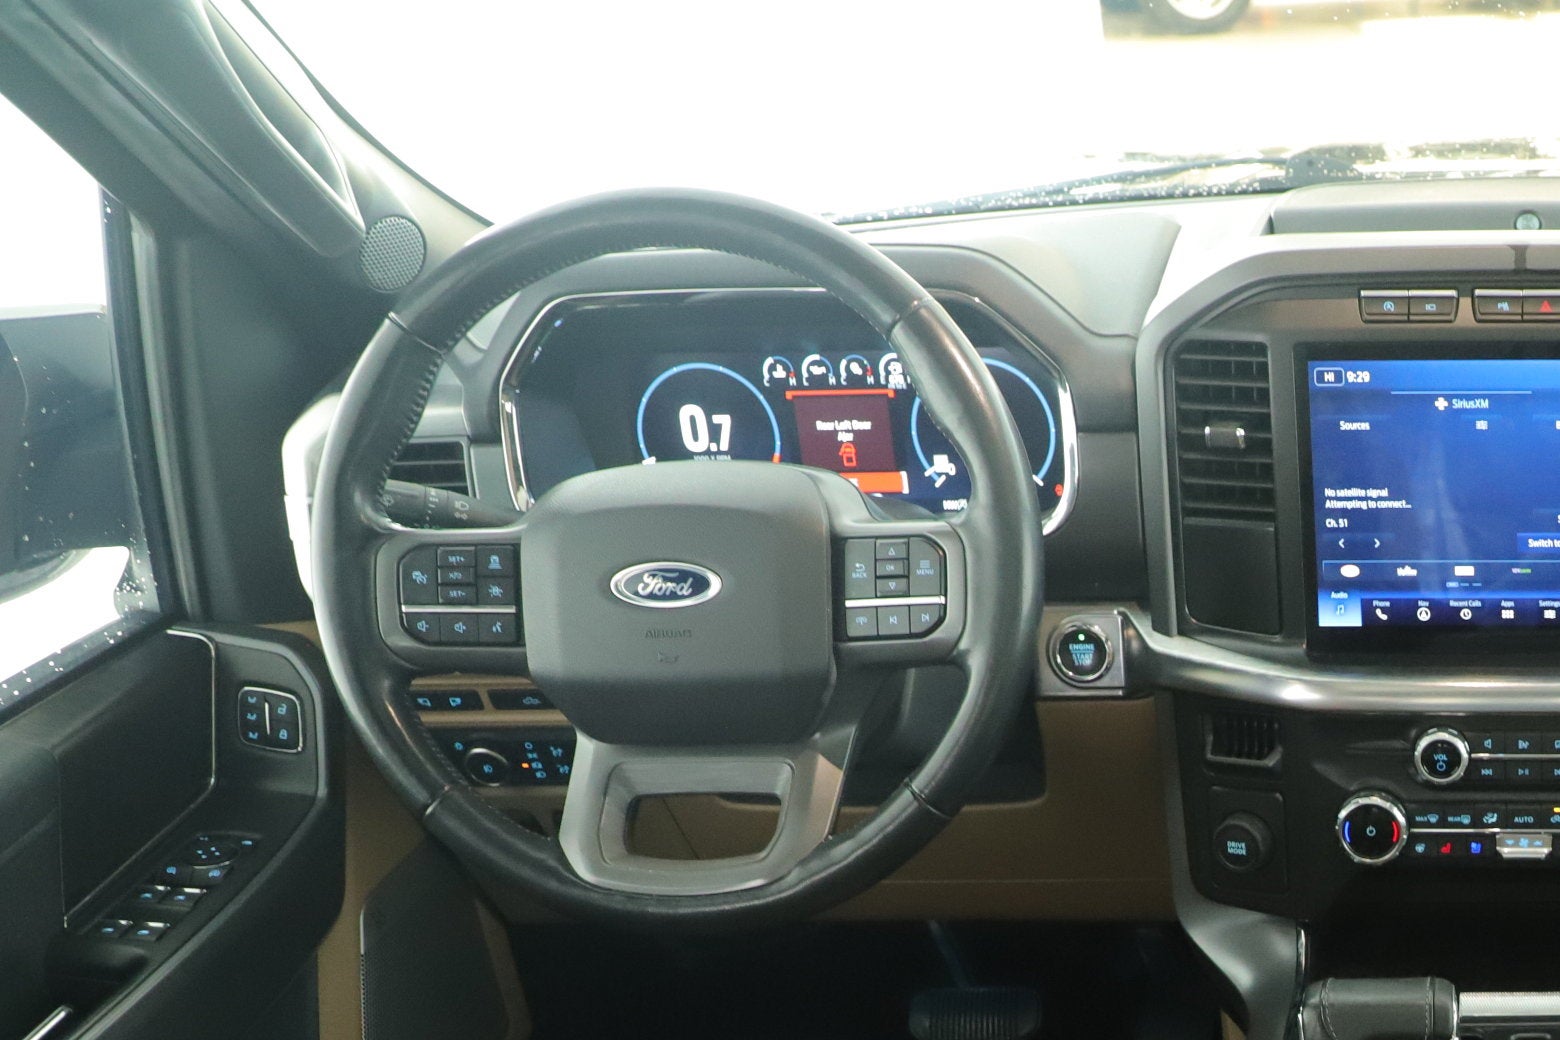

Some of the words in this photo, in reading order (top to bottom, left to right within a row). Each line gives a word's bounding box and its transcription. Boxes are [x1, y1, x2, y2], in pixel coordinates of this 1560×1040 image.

[1324, 372, 1335, 382] HI
[1346, 371, 1371, 383] 9:29
[1452, 399, 1489, 409] SiriusXM
[679, 404, 732, 453] 0.7
[1340, 421, 1370, 430] Sources
[1324, 488, 1334, 497] No
[1336, 488, 1365, 497] satellite
[1366, 488, 1388, 499] signal
[1325, 499, 1367, 510] Attempting
[1368, 500, 1377, 509] to
[1377, 500, 1412, 509] connect...
[1325, 518, 1338, 528] Ch.
[1338, 518, 1348, 528] 51
[1528, 539, 1552, 548] Switch
[1553, 539, 1560, 548] to
[637, 571, 693, 596] Ford
[1331, 591, 1348, 599] Audio
[1500, 600, 1515, 608] Apps
[1538, 600, 1560, 608] Settings
[1514, 816, 1534, 824] AUTO
[1227, 840, 1245, 848] DRIVE
[1228, 847, 1247, 856] MODE
